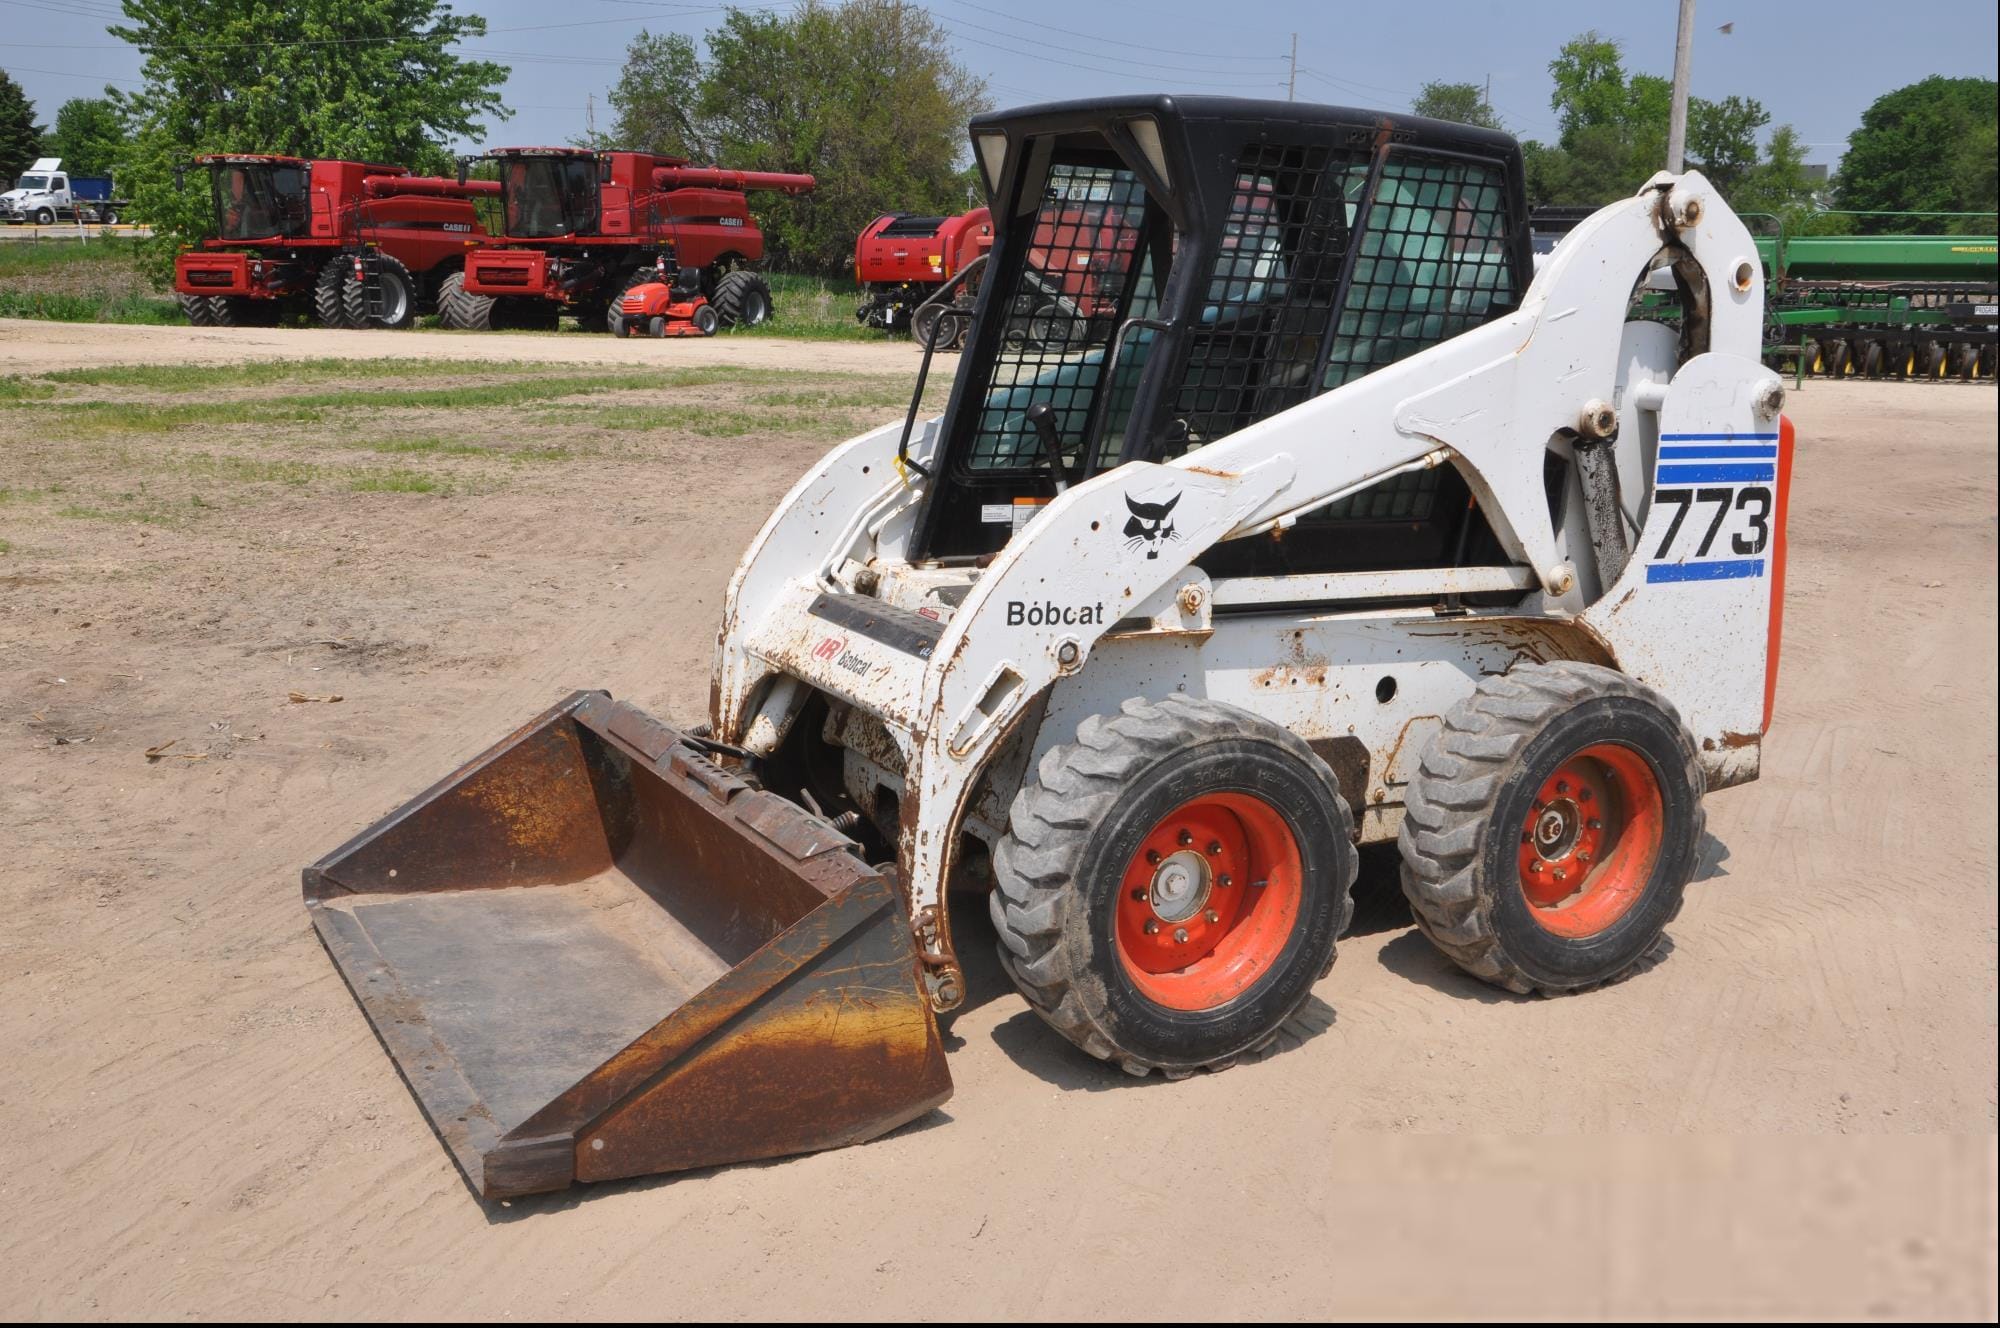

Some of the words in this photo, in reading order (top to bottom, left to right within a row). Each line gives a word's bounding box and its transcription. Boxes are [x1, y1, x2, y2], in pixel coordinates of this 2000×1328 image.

[1653, 486, 1772, 560] 773
[1006, 600, 1104, 626] Bobcat
[815, 638, 842, 660] IR
[837, 649, 873, 677] Bobcat
